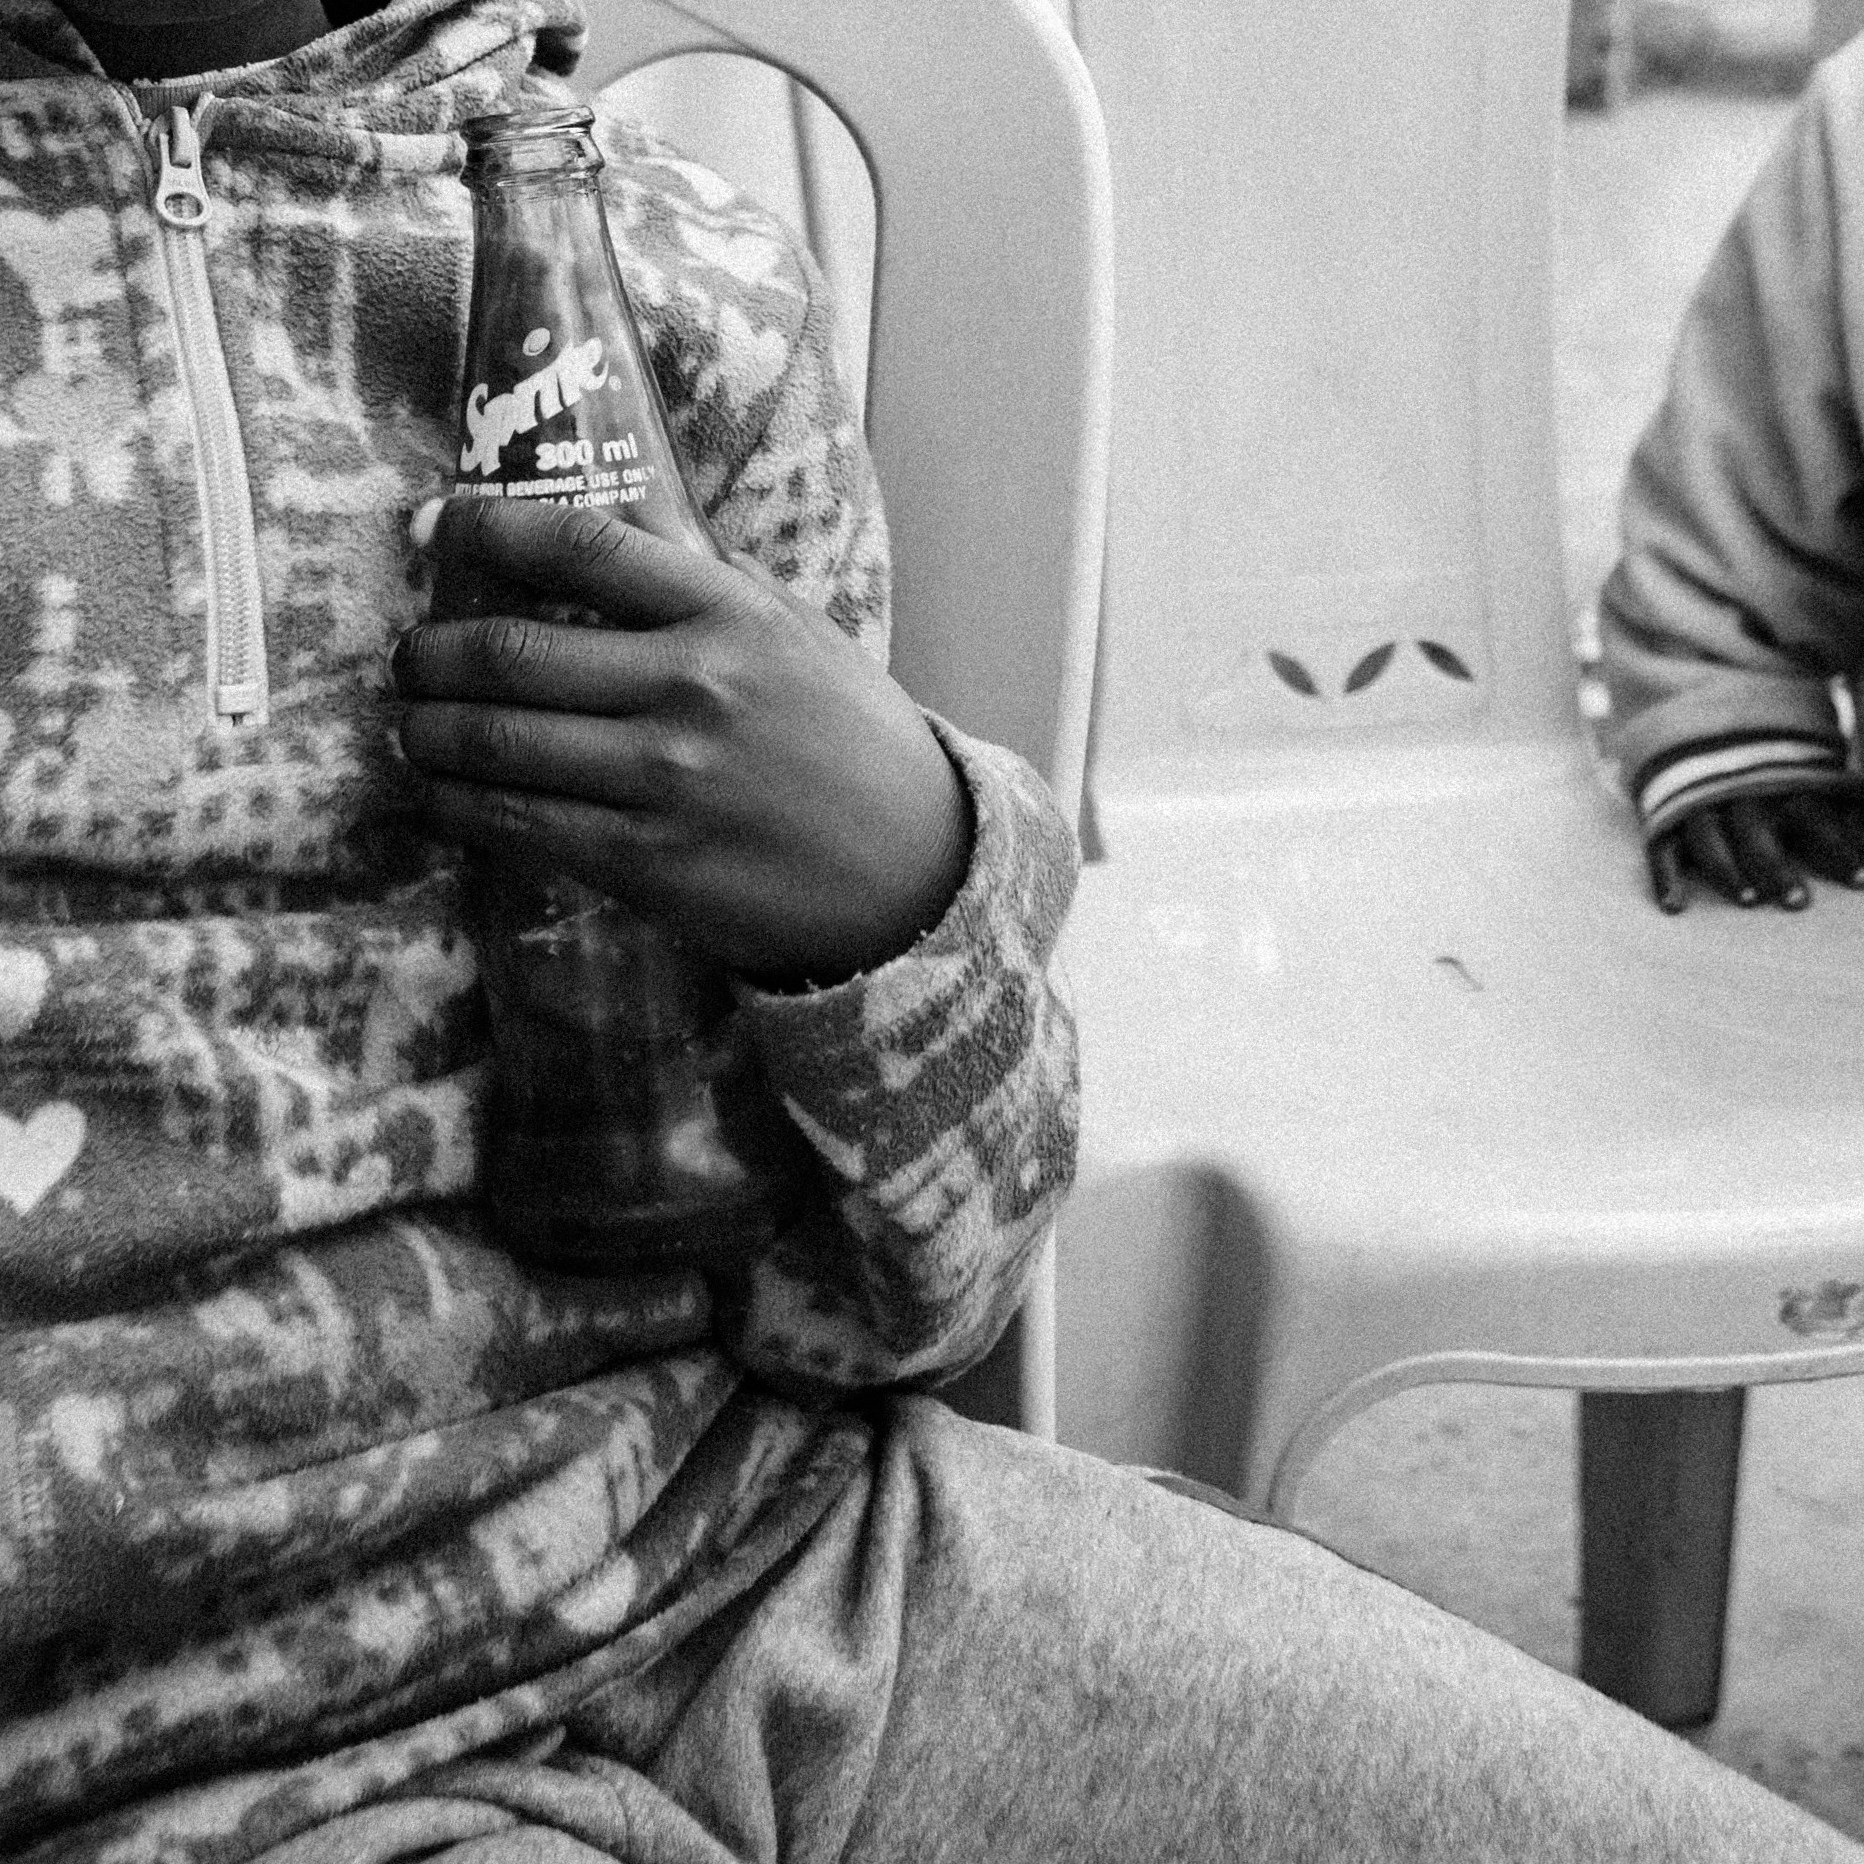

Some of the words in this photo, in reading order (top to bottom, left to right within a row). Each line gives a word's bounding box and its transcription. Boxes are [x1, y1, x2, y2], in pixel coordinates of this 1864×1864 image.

[460, 327, 610, 477] Sprite
[535, 439, 595, 471] 300
[602, 432, 638, 462] ml
[506, 475, 586, 497] BEVERAGE
[587, 471, 620, 489] USE
[622, 465, 656, 484] ONLY
[573, 485, 646, 508] COMPANY
